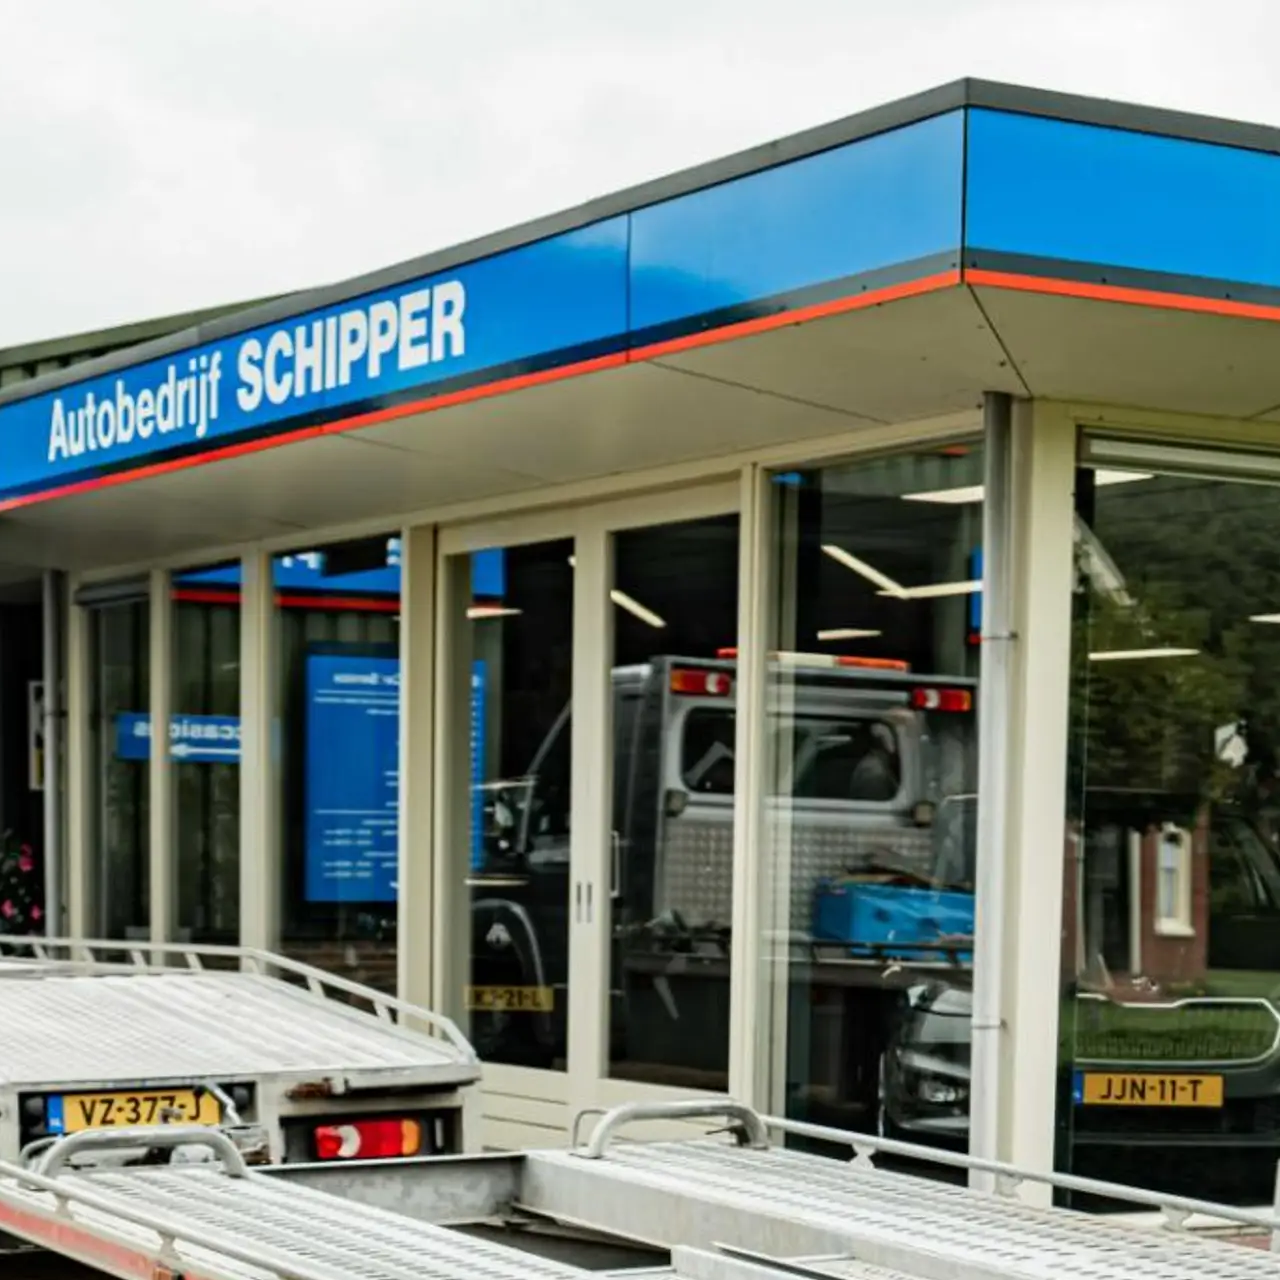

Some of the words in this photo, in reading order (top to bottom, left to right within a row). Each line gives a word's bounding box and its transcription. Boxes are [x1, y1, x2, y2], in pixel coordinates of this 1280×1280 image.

[47, 351, 222, 464] Autobedrijf
[235, 280, 466, 413] SCHIPPER
[1099, 1077, 1203, 1102] JJN-11-T
